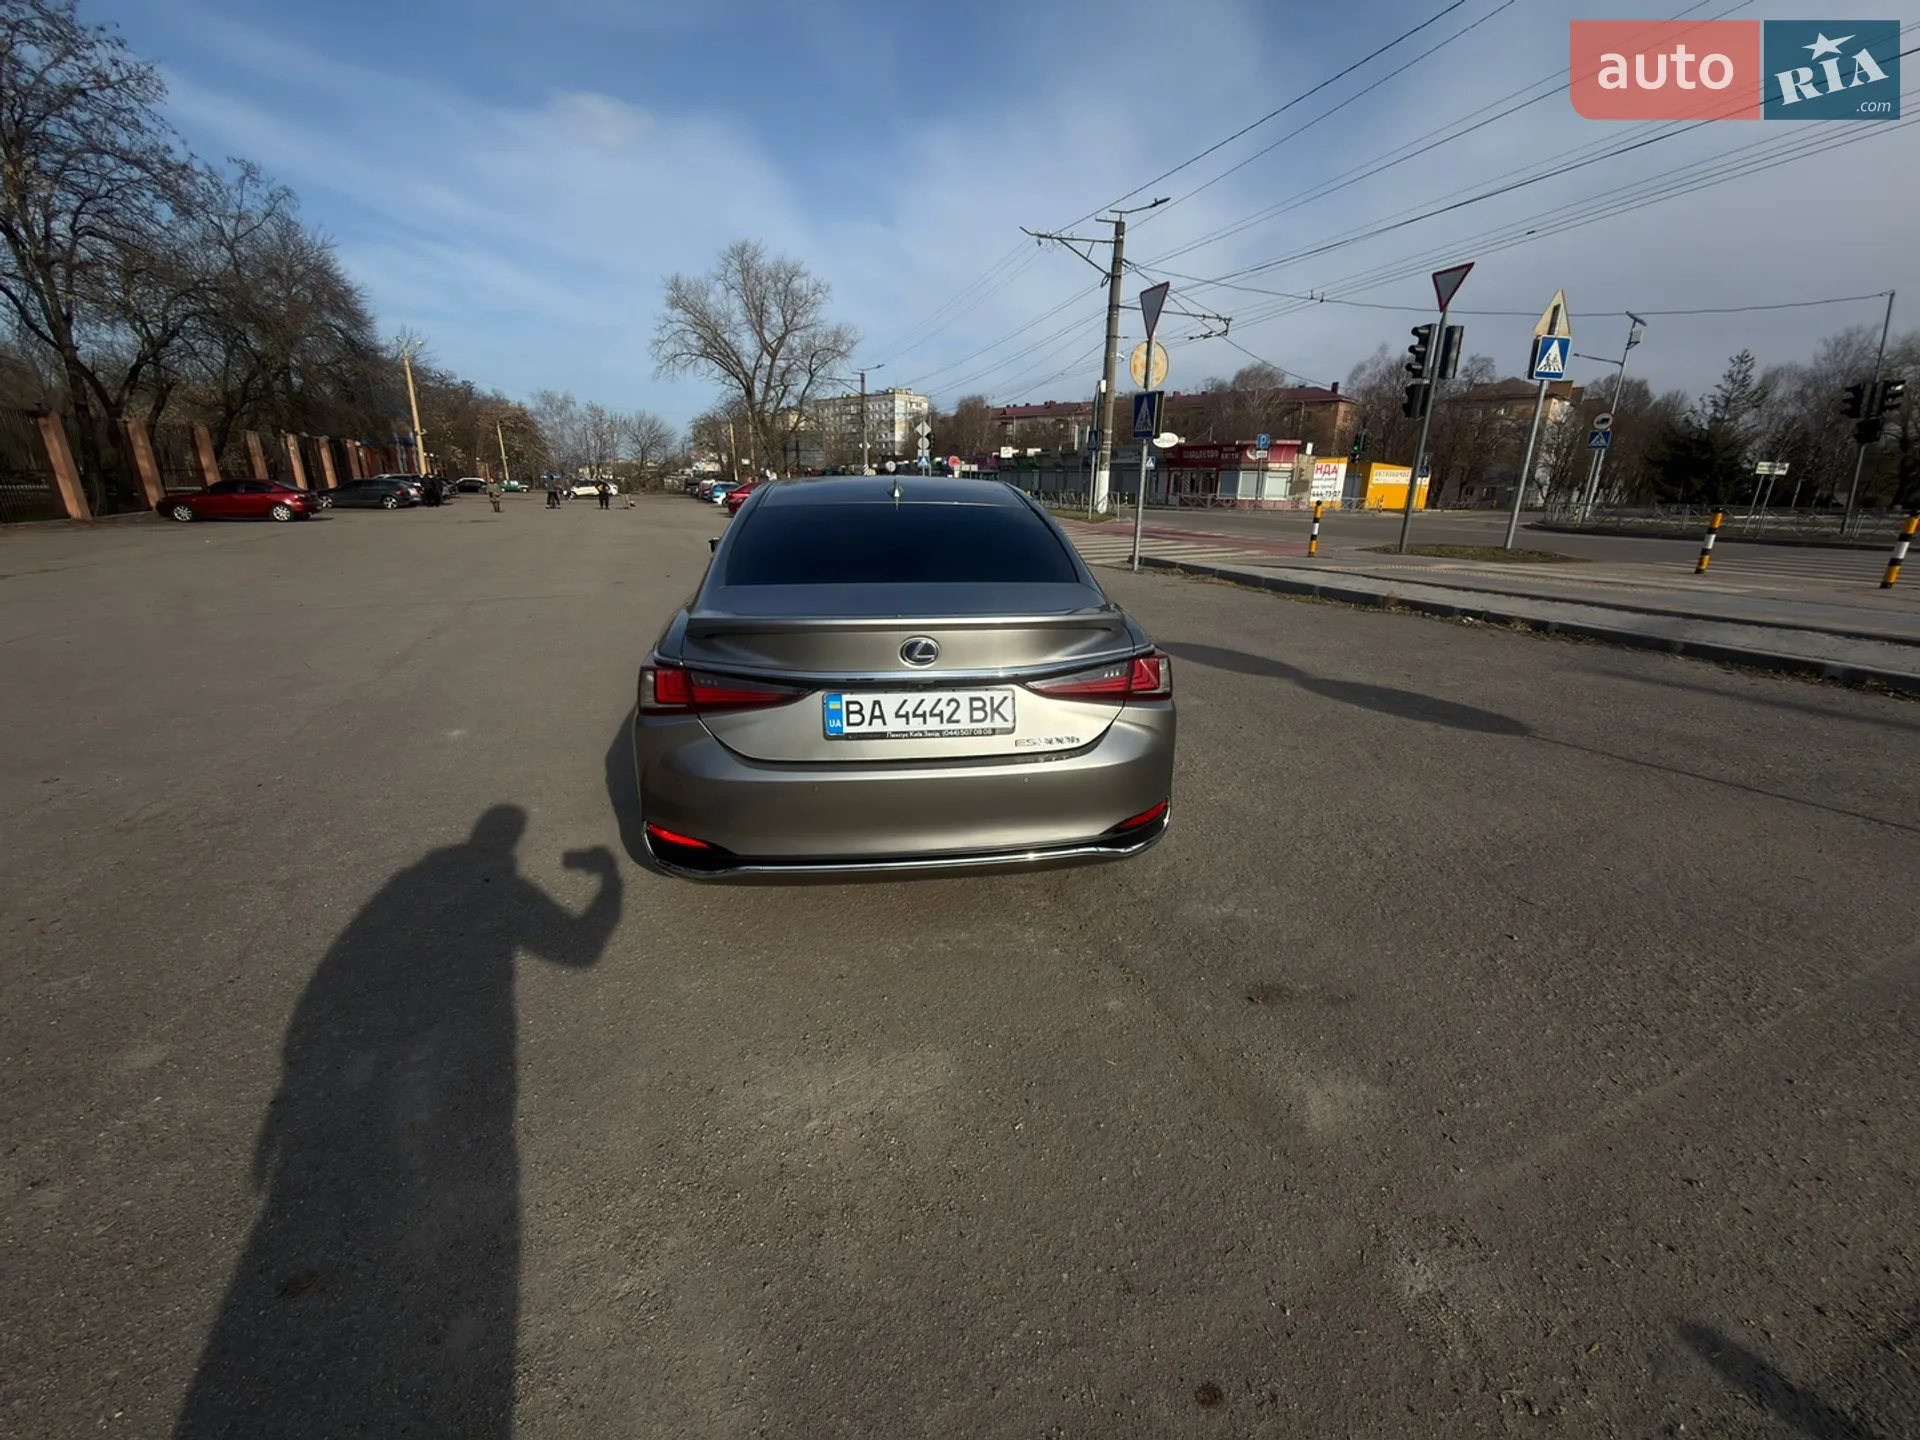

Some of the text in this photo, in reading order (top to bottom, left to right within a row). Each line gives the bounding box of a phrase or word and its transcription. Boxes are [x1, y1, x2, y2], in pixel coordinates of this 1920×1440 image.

[845, 696, 1010, 727] BA 4442 BK
[829, 719, 842, 728] UA
